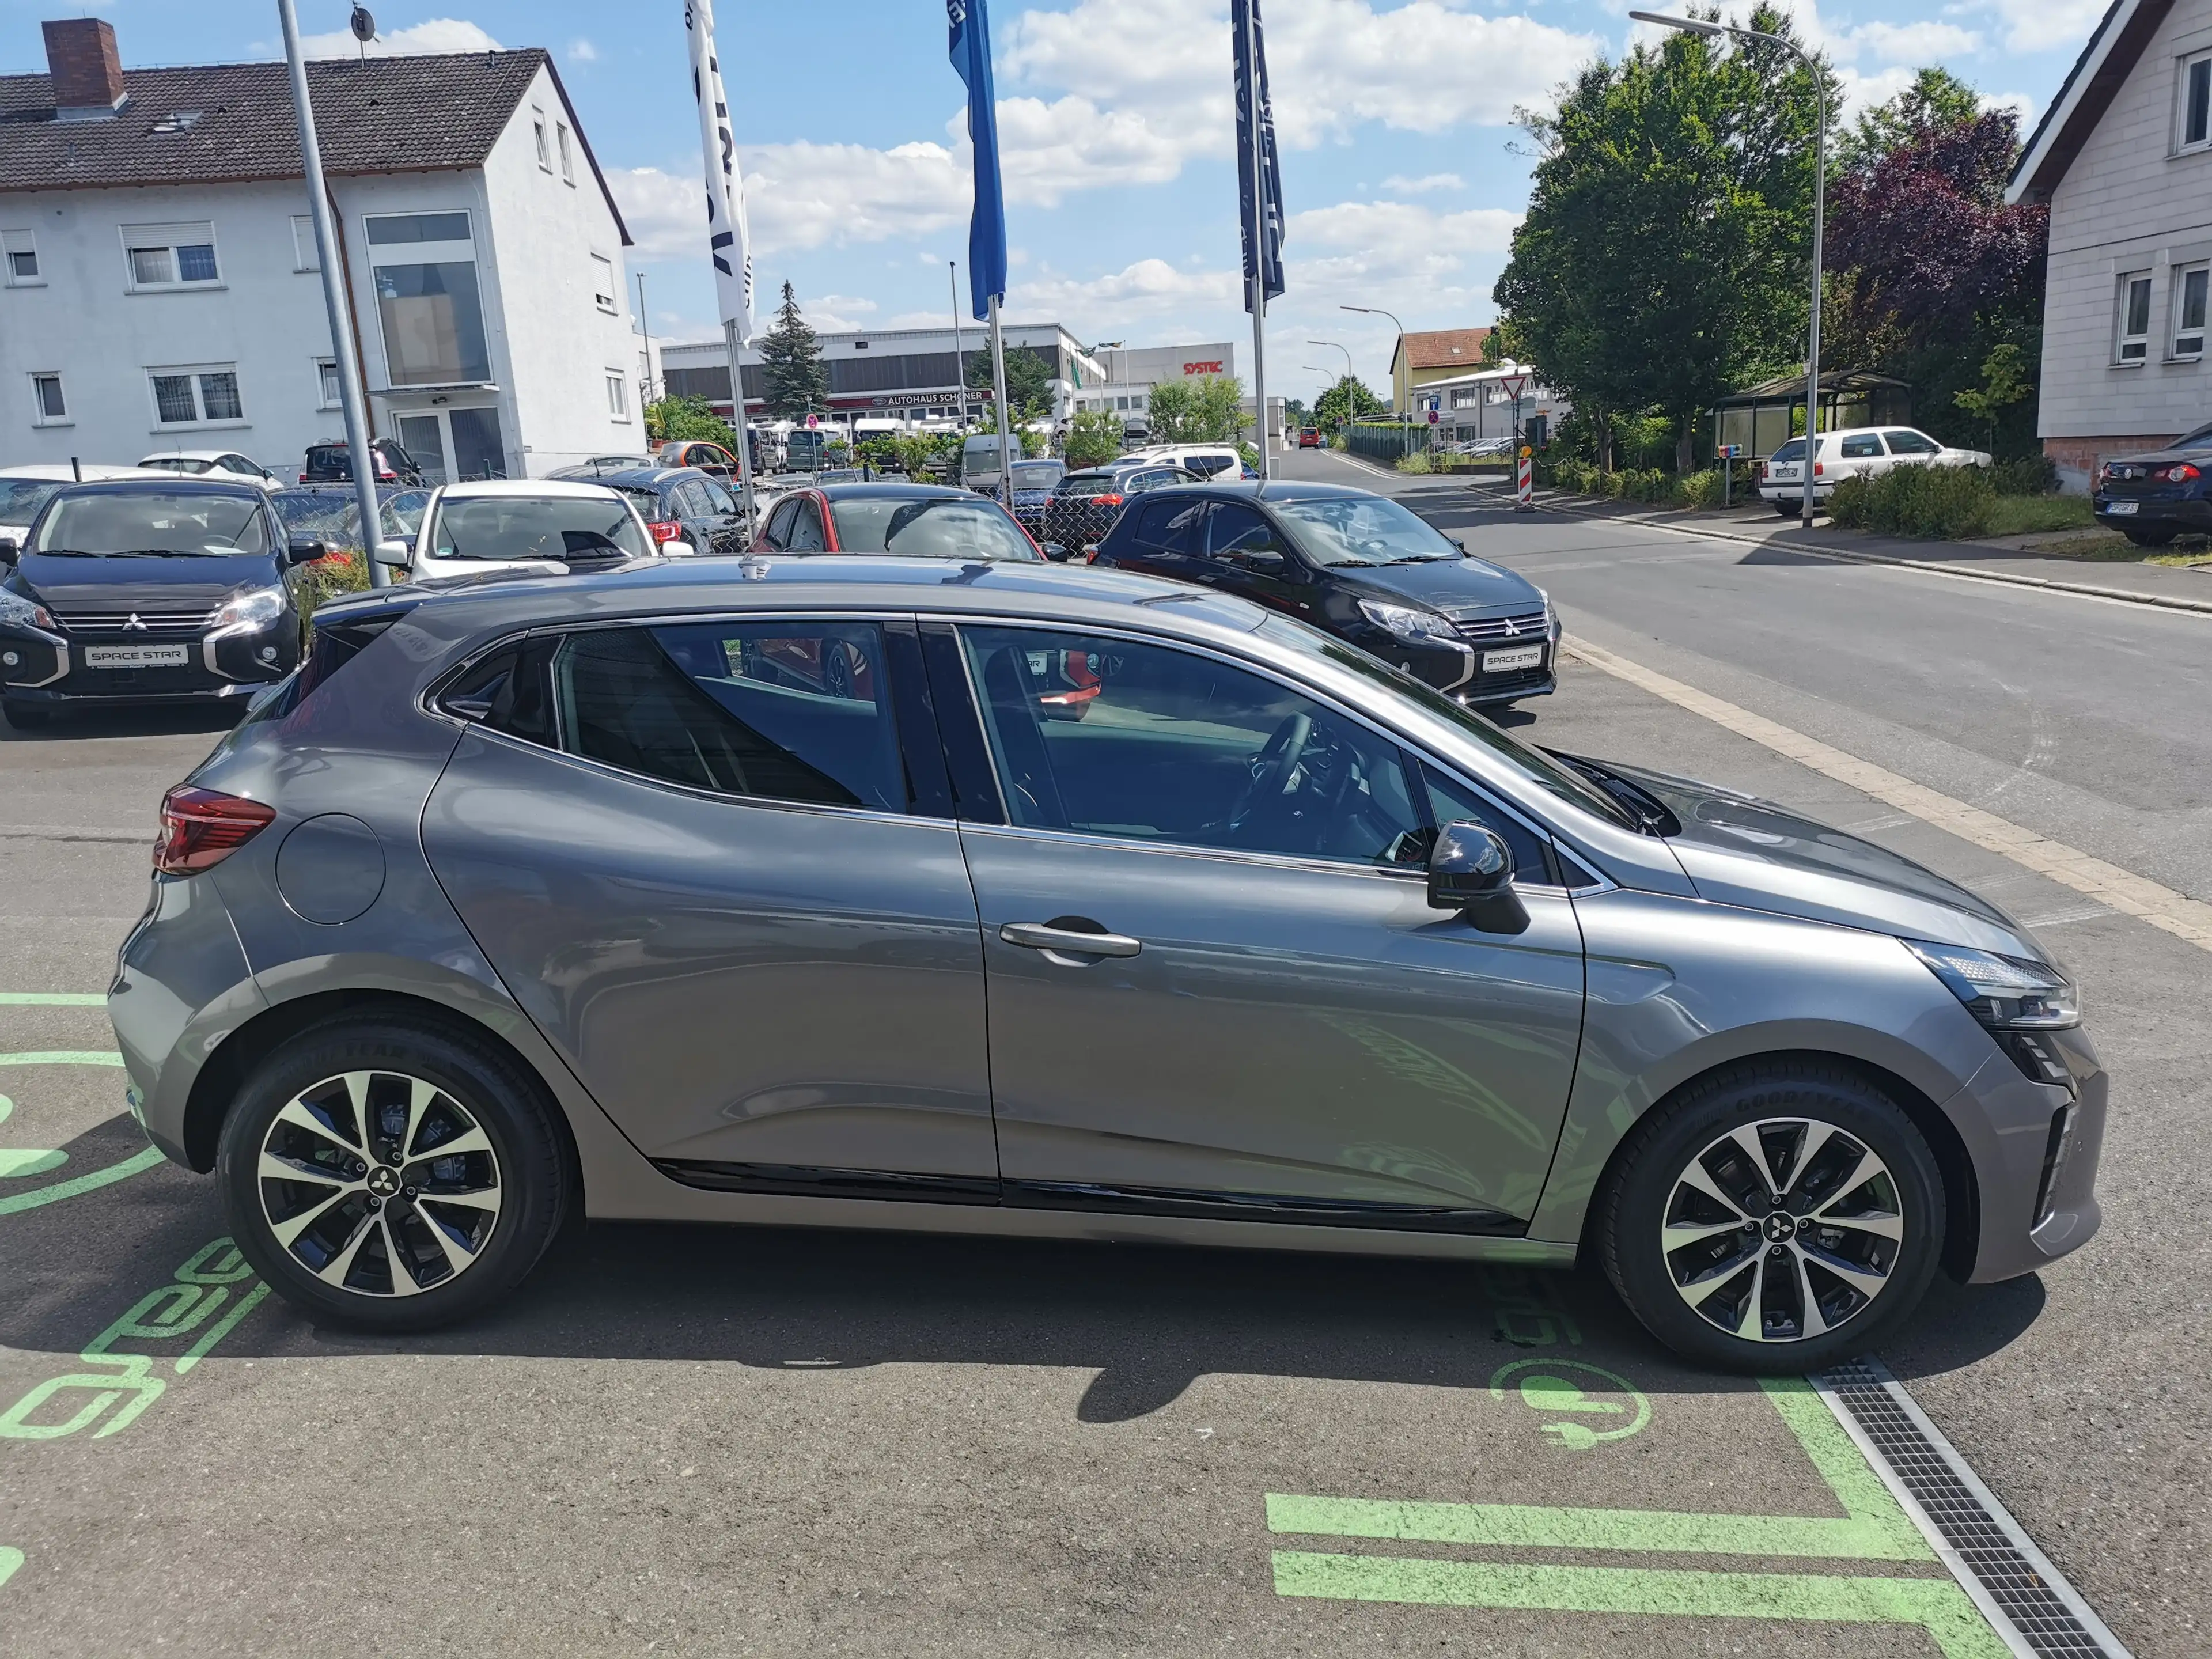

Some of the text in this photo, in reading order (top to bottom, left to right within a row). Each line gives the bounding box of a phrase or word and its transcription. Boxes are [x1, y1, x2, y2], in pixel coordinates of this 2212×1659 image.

[1183, 360, 1223, 375] SYSTEC
[888, 394, 937, 406] AUTOHAUS
[92, 650, 181, 661] SPACE STAR
[1487, 653, 1539, 665] SPACE STAR
